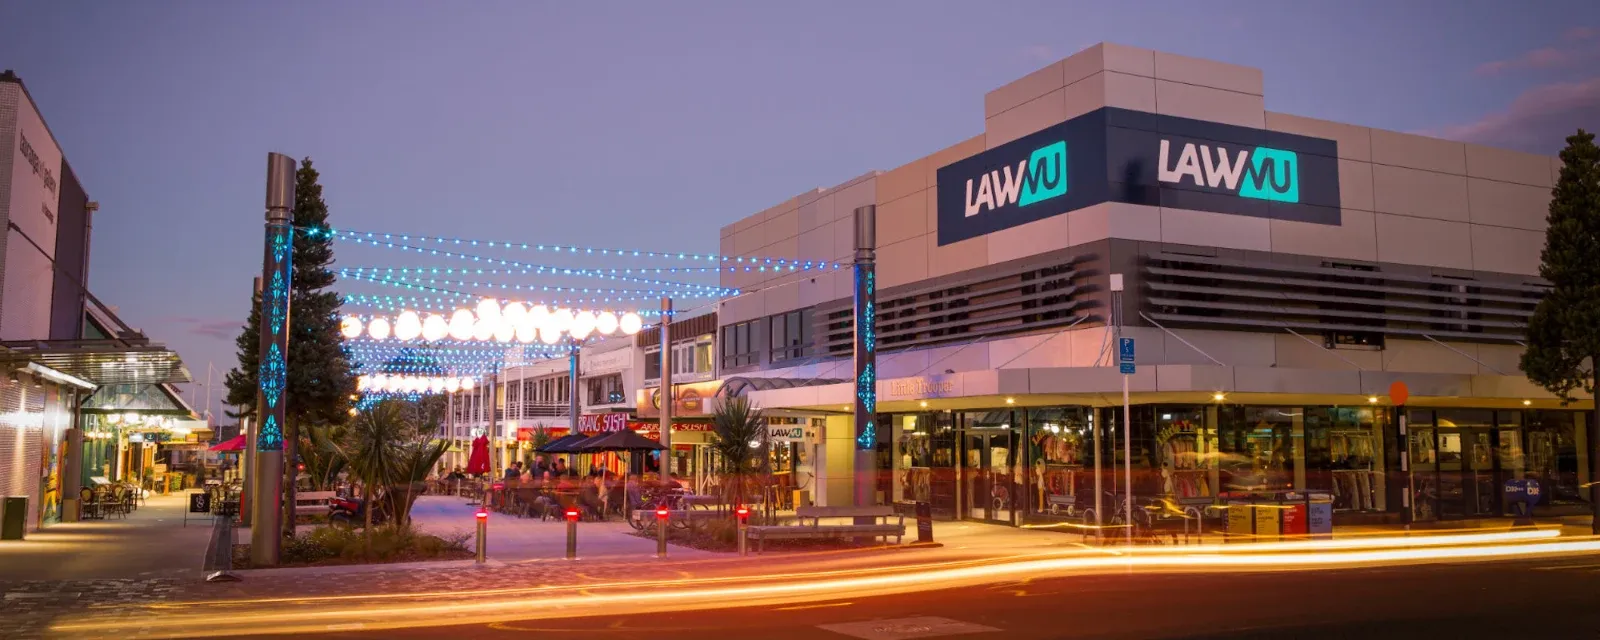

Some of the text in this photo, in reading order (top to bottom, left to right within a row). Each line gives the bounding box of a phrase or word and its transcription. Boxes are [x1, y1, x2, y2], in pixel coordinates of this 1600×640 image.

[964, 150, 1064, 217] LAWVU
[1158, 139, 1293, 199] LAWVU
[890, 378, 953, 396] Little Trooper
